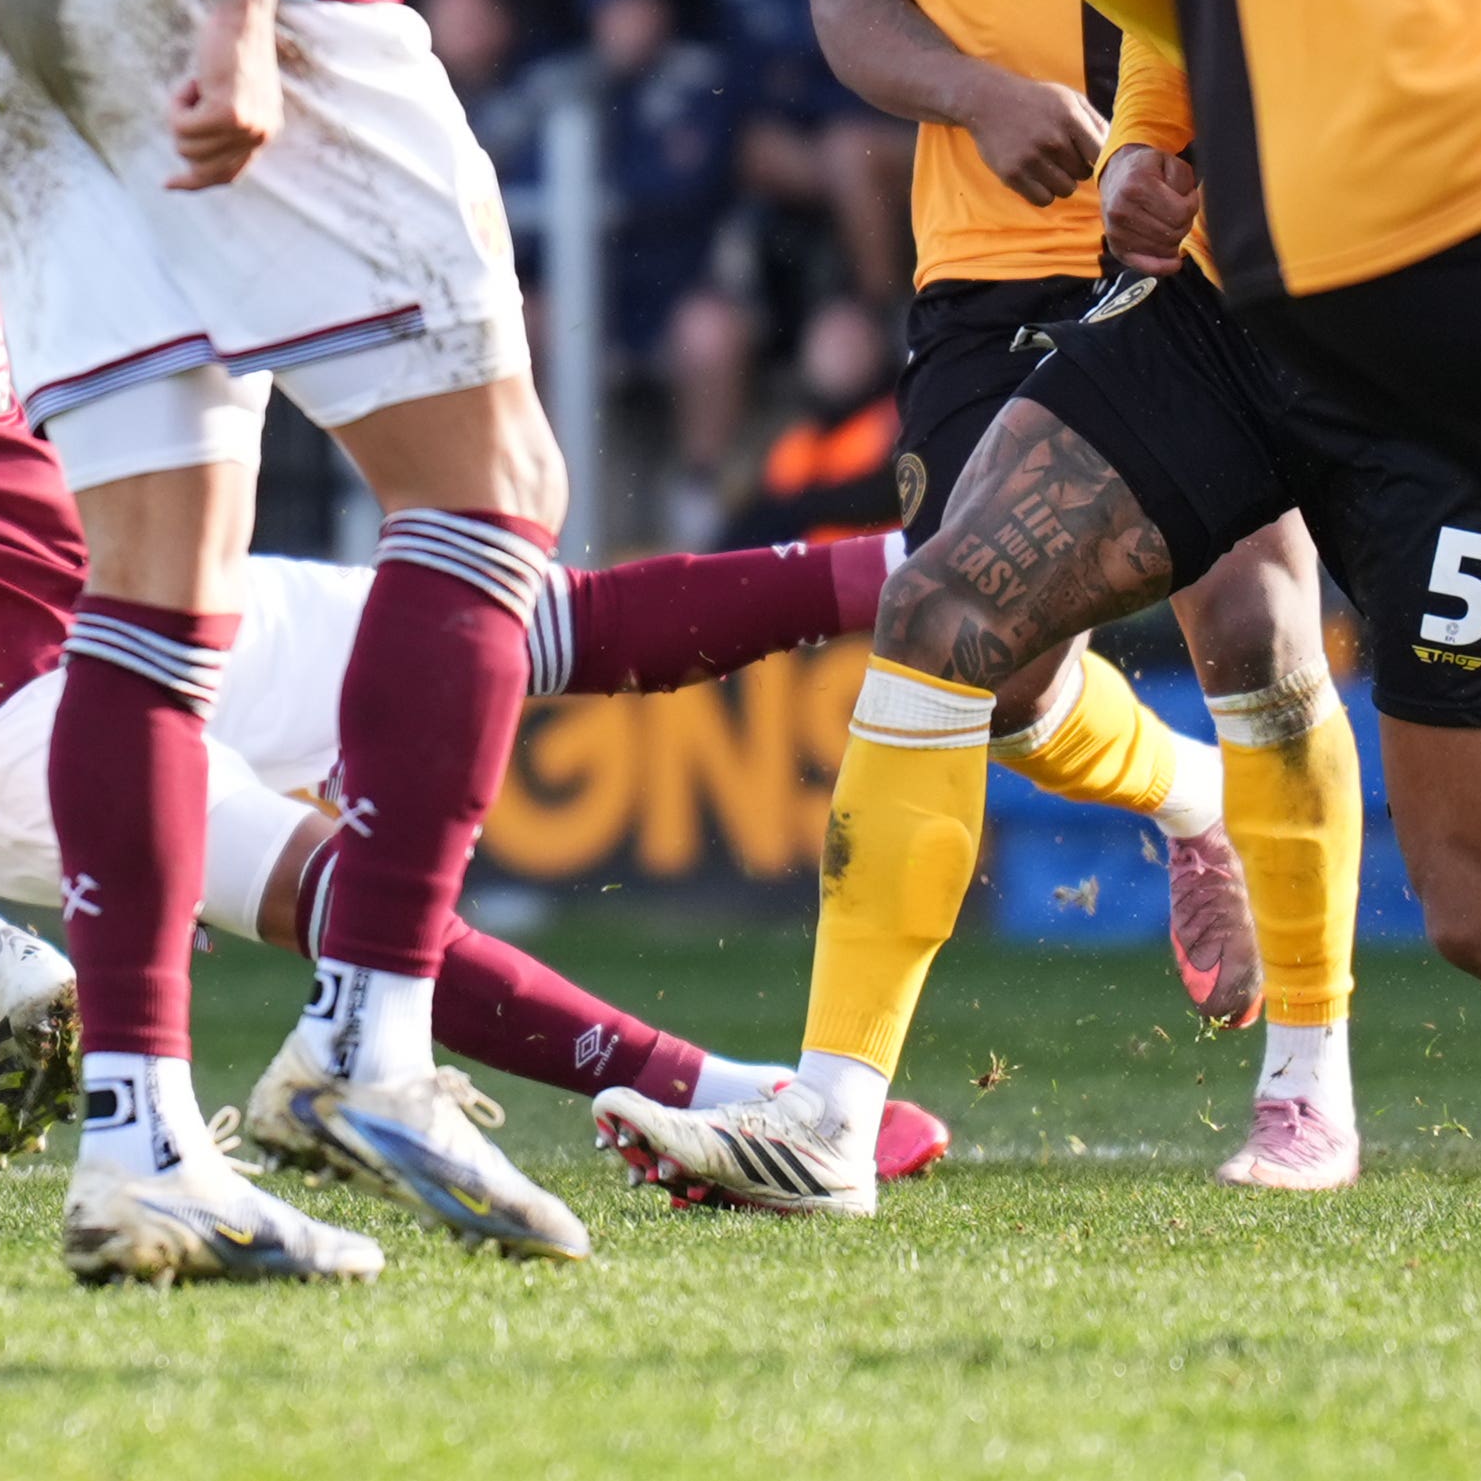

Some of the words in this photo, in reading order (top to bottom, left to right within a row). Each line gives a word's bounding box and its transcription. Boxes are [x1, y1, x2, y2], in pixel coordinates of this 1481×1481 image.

[992, 522, 1040, 570] NUH
[1011, 491, 1075, 559] LIFE
[946, 533, 1028, 608] EASY
[593, 1034, 619, 1076] umbro
